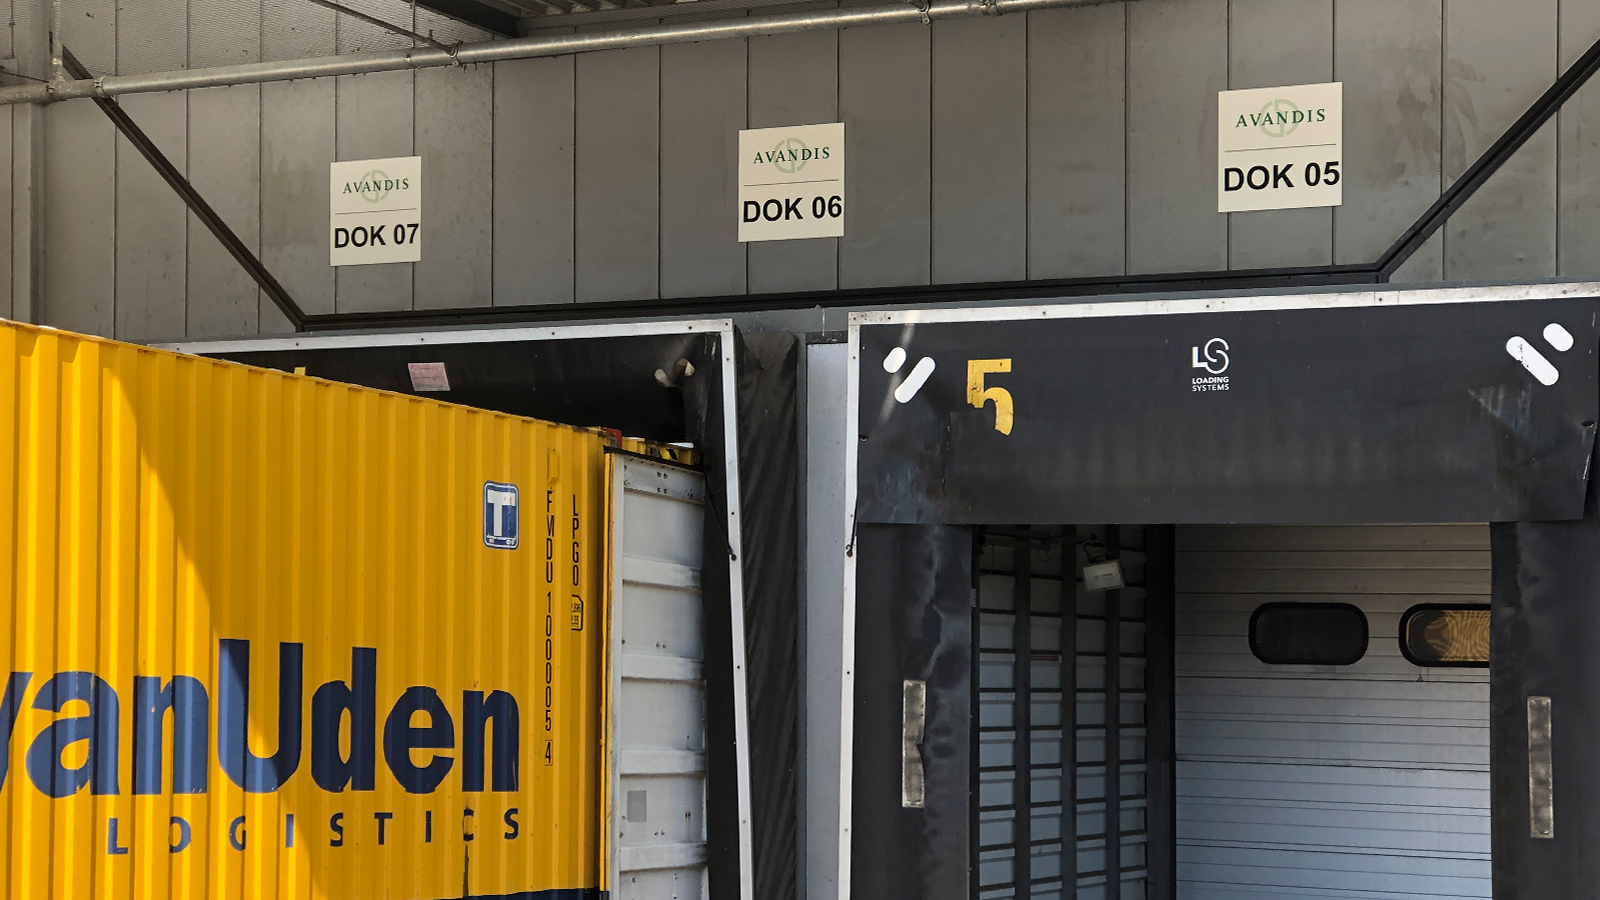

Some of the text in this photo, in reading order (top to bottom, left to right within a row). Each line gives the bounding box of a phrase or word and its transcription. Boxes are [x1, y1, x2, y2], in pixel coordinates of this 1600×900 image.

[1235, 108, 1326, 128] AVANDIS
[753, 146, 830, 164] AVANDIS
[342, 178, 409, 194] AVANDIS
[1224, 161, 1340, 192] DOK 05
[743, 195, 843, 223] DOK 06
[334, 223, 420, 249] DOK 07
[1192, 376, 1230, 385] LOADING
[1192, 384, 1230, 392] SYSTEMS
[967, 358, 1014, 436] 5
[487, 489, 516, 537] T
[544, 741, 552, 764] 4
[107, 807, 520, 856] LOGISTICS
